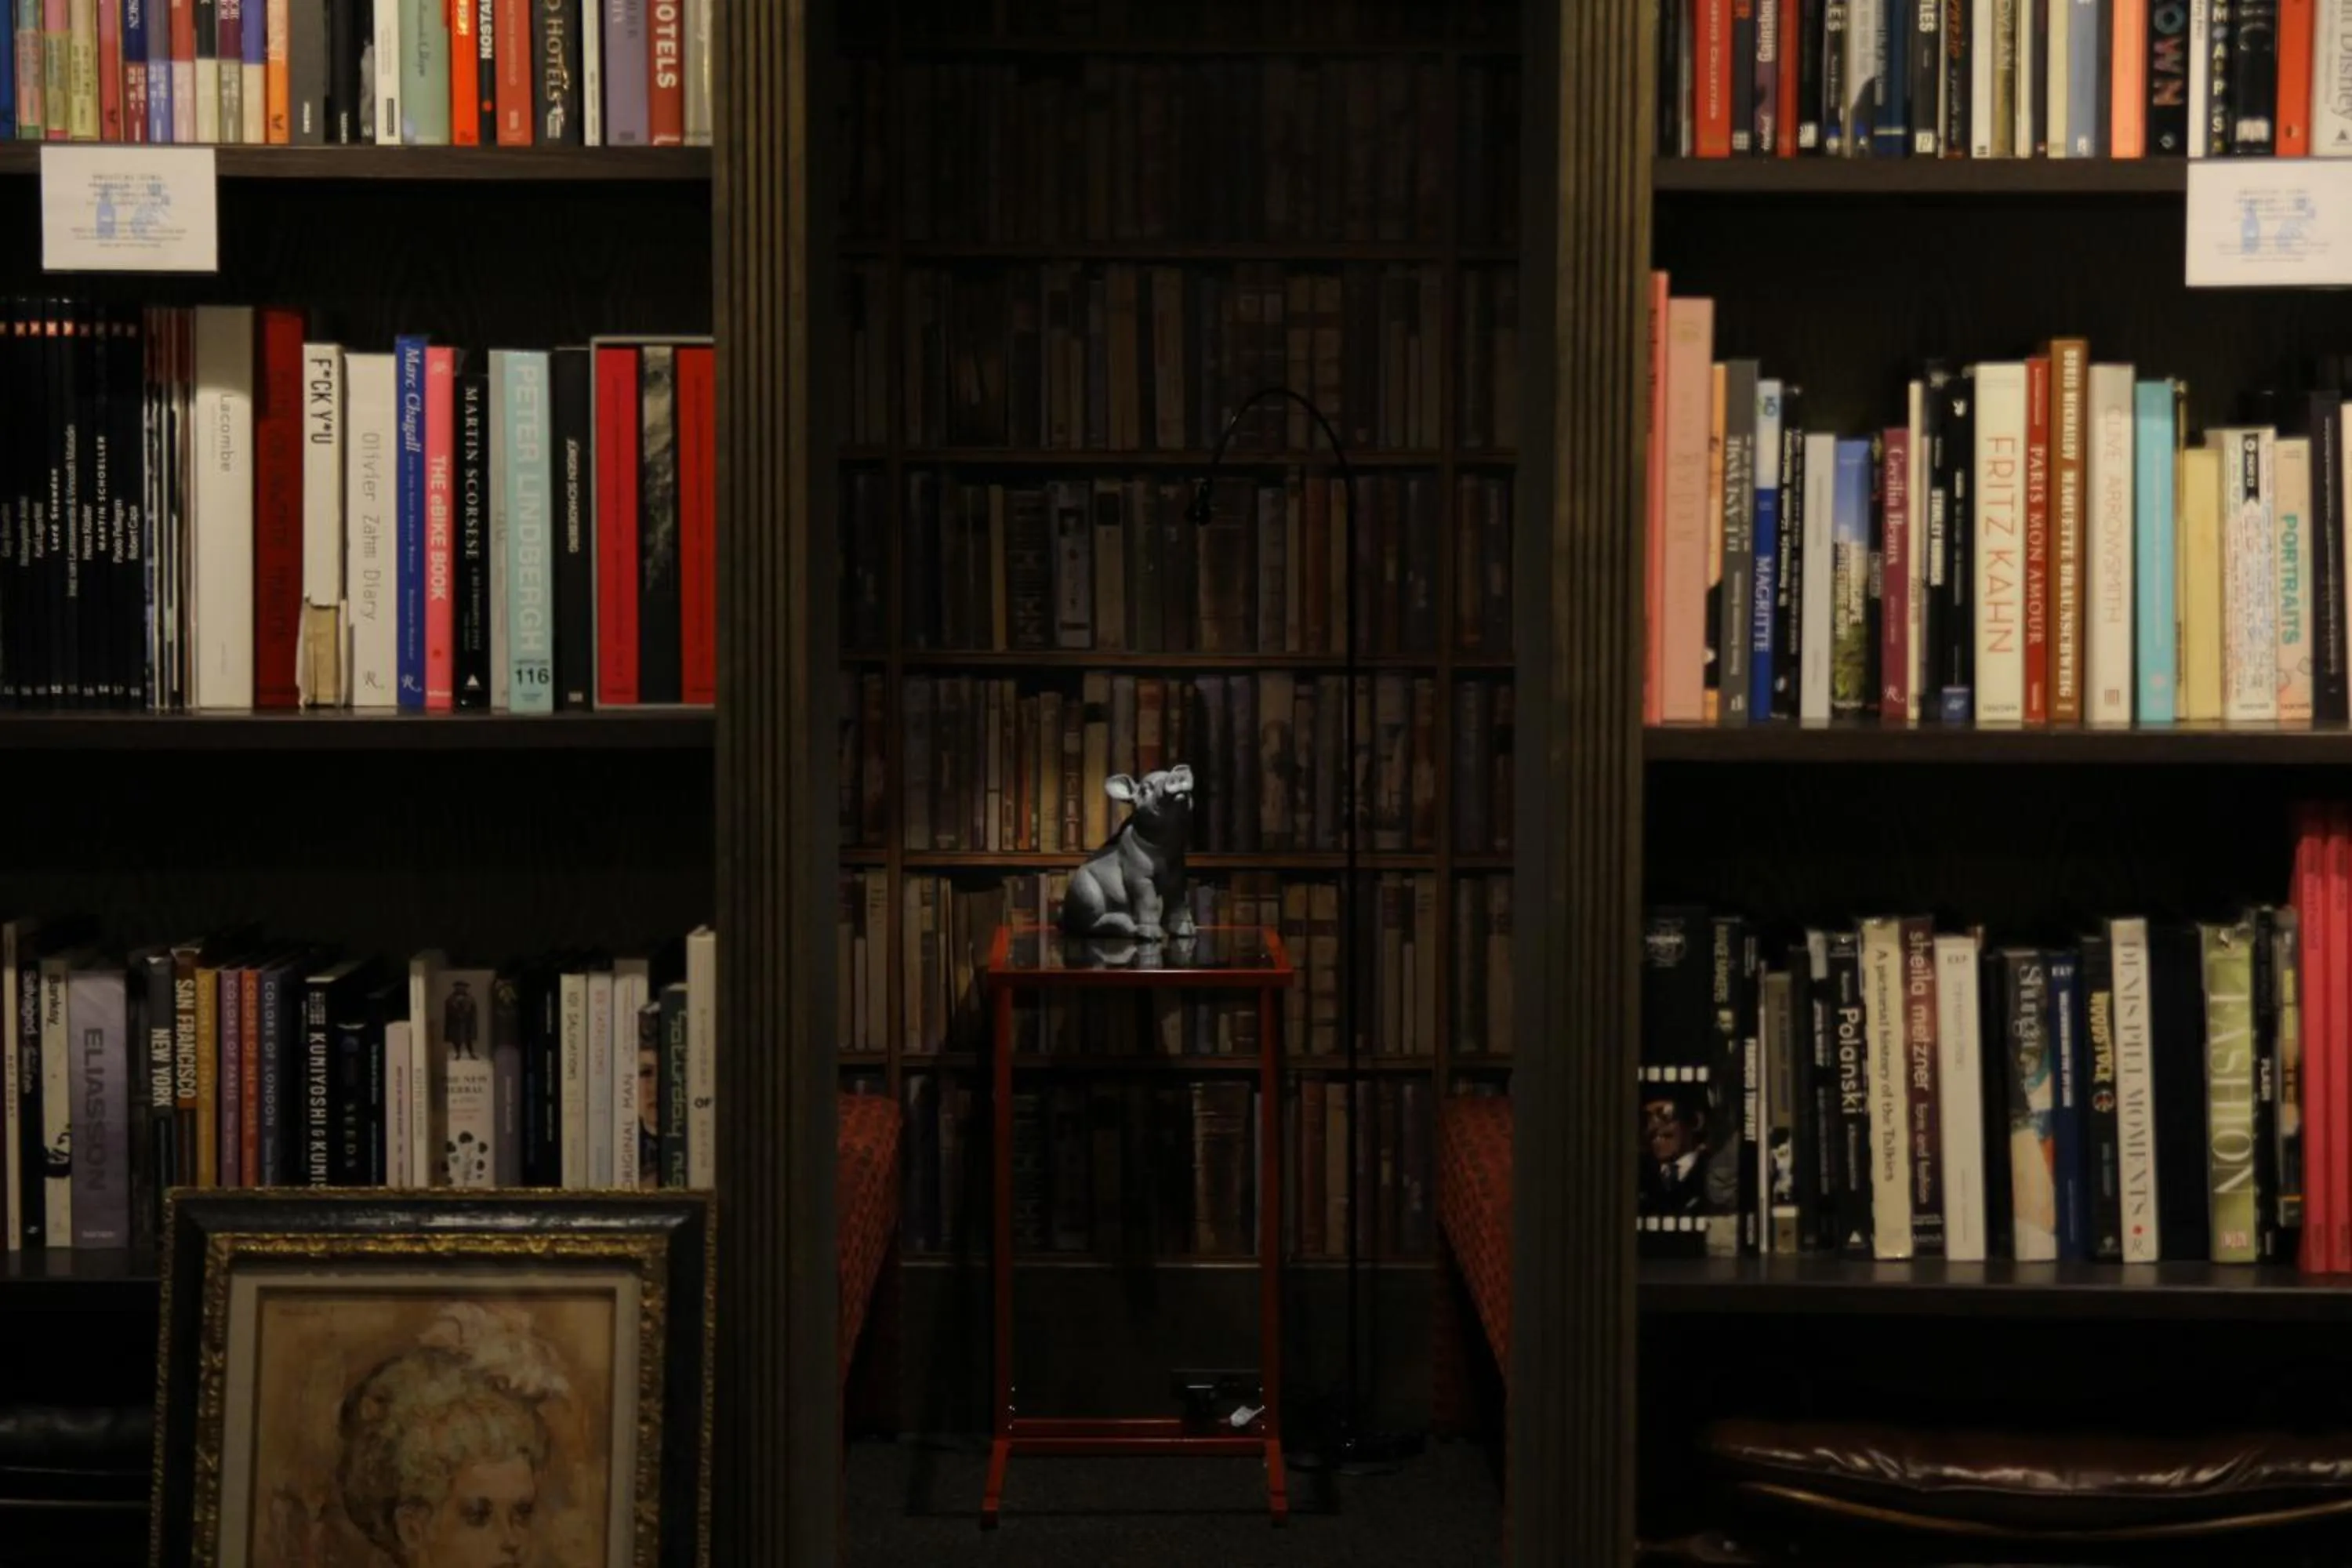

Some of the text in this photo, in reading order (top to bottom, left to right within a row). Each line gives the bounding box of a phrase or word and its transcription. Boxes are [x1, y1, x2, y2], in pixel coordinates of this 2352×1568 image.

[479, 0, 493, 60] NOSTA
[655, 0, 677, 89] OTELS
[2151, 0, 2186, 107] OWN
[405, 347, 420, 387] Marc
[220, 394, 235, 473] Lacombe
[402, 393, 420, 452] Chagall
[465, 387, 480, 462] MARTIN
[96, 436, 107, 551] MARTIN SCHOELLER
[465, 468, 480, 560] SCORSESE
[517, 365, 544, 651] PETER LINDBERGH
[1886, 445, 1904, 507] Cecilia
[361, 432, 381, 621] Olivier Zahm Diary
[430, 455, 448, 601] THE eBIKE BOOK
[1984, 436, 2015, 652] FRITZ KAHN
[2027, 443, 2045, 645] PARIS MON AMOUR
[1753, 555, 1773, 653] MAGRITTE
[2280, 514, 2300, 644] PORTRAITS
[516, 667, 550, 685] 116
[47, 973, 63, 1026] Banksy
[1909, 931, 1931, 996] sheila
[2013, 964, 2045, 1049] Shunga
[2118, 939, 2140, 1016] DENIS
[151, 1028, 172, 1108] NEW YORK
[175, 978, 196, 1099] SAN FRANCISCO
[308, 1032, 327, 1126] KUNIYOSHI
[1837, 1007, 1863, 1114] Polanski
[1874, 949, 1896, 1182] A pictorial history of the Talkies
[1911, 1004, 1933, 1092] metzner
[2088, 990, 2114, 1083] WOODSTOCK
[83, 1027, 107, 1190] ELIASSON
[263, 1065, 276, 1127] LONDON
[2209, 991, 2255, 1196] FASHION
[2124, 1087, 2147, 1217] MOMENTS
